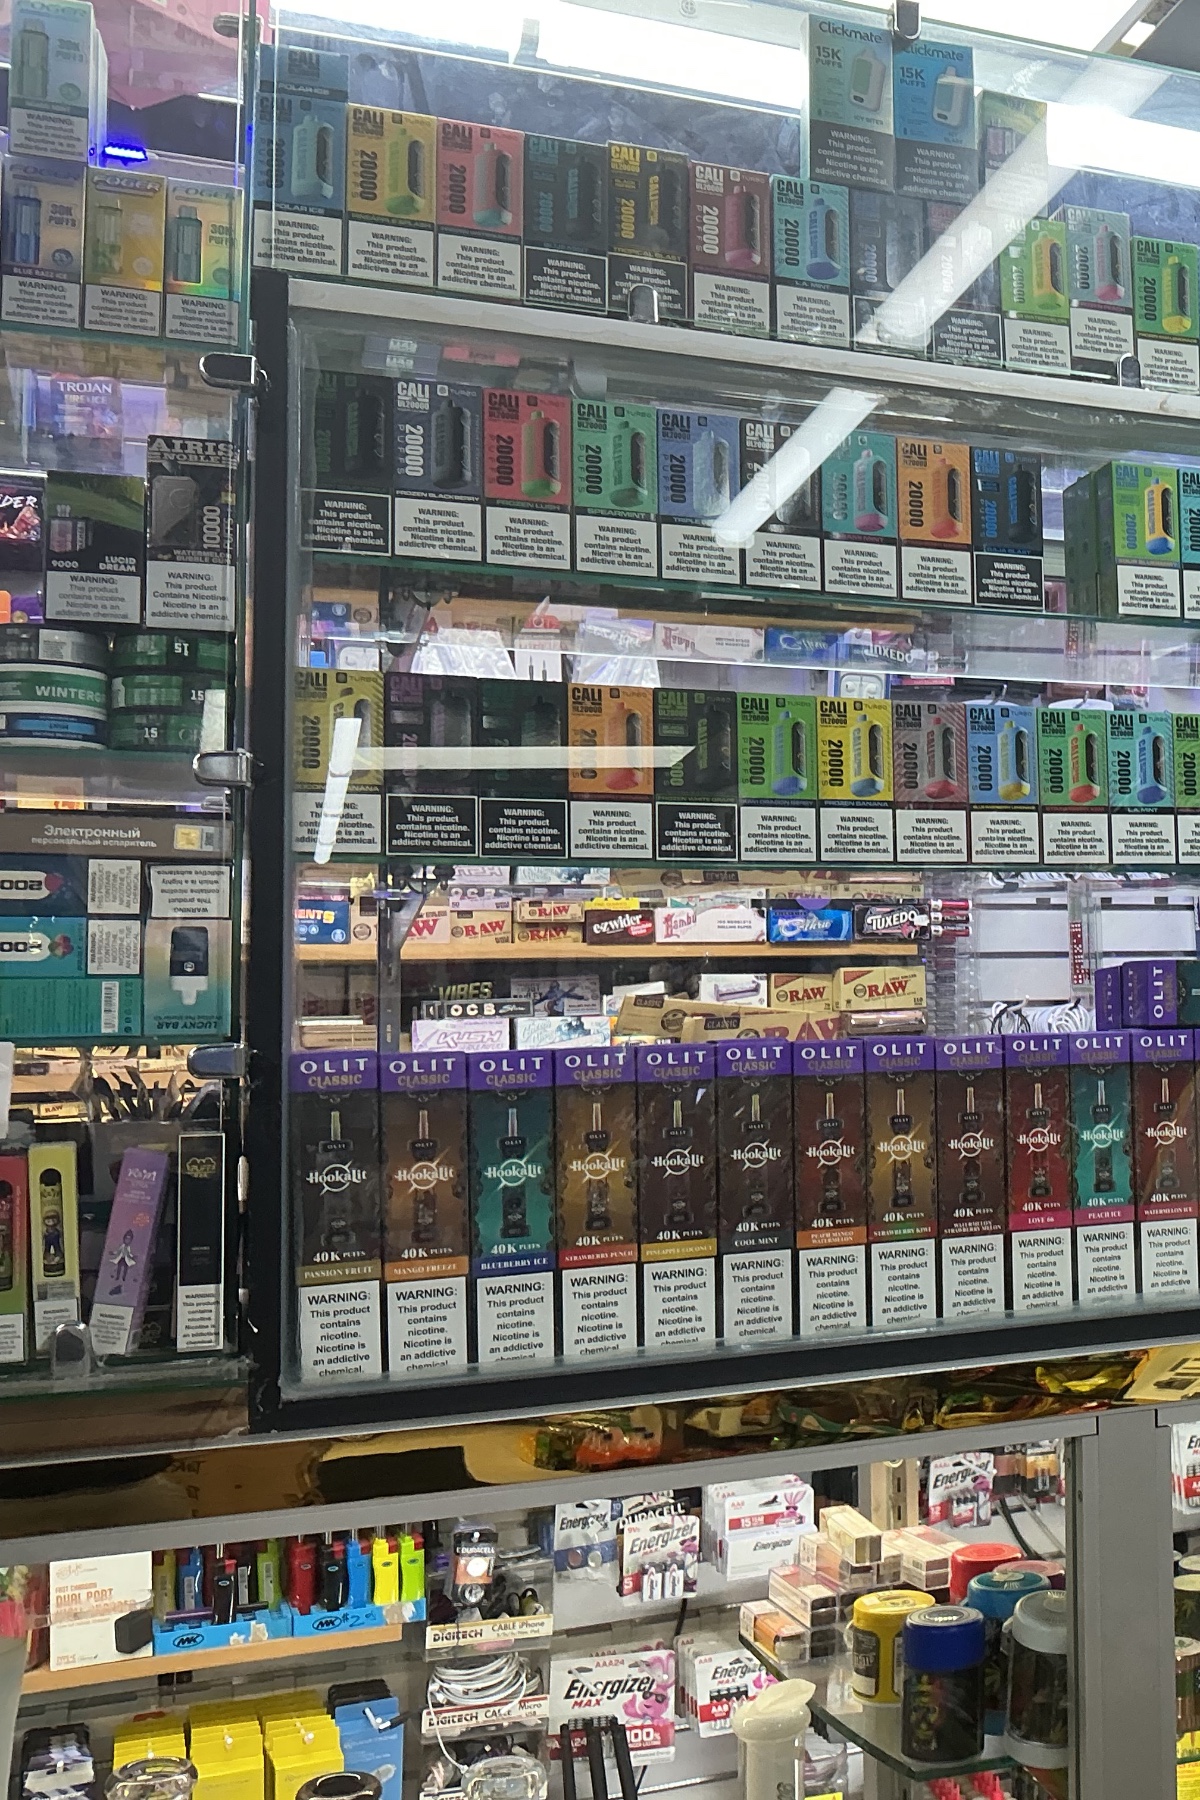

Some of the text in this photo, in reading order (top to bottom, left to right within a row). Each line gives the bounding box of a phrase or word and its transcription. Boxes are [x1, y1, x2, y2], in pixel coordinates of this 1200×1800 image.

[819, 21, 883, 43] Clickmate
[816, 45, 841, 61] 15K
[815, 58, 843, 69] PUFFS
[899, 66, 925, 81] 15K
[278, 82, 310, 95] POLAR
[899, 79, 926, 88] PUFFS
[353, 108, 384, 125] CALI
[830, 129, 873, 144] WARNING:
[828, 139, 877, 157] This product
[359, 149, 378, 201] 20000
[278, 219, 320, 232] WARNING:
[57, 382, 112, 394] TROJAN
[397, 382, 430, 398] CALI
[577, 404, 607, 420] CALI
[151, 438, 234, 456] AIRIS
[405, 424, 424, 478] 20000
[586, 444, 602, 495] 20000
[396, 490, 480, 502] FROZEN BLACKBERRY
[909, 481, 924, 528] 20000
[419, 508, 460, 518] WARNING:
[587, 508, 645, 520] SPEARMINT
[203, 505, 221, 550] 10000
[413, 517, 465, 529] This product
[403, 526, 475, 537] contains nicotine.
[399, 541, 478, 553] addictive chemical.
[52, 560, 79, 568] 9000
[105, 556, 136, 565] LUCID
[99, 563, 136, 573] DREAM
[167, 572, 215, 582] WARNING:
[164, 581, 218, 593] This product
[190, 690, 204, 701] 15
[572, 687, 602, 701] CALI
[741, 697, 769, 710] CALI
[820, 700, 847, 714] CALI
[1110, 714, 1133, 727] CALI
[144, 728, 158, 739] 15
[749, 737, 765, 785] 20000
[828, 740, 844, 787] 20000
[1117, 750, 1132, 795] 20000
[824, 800, 855, 808] FROZEN
[593, 810, 631, 818] WARNING:
[44, 825, 141, 839] Электронный
[537, 905, 570, 917] RAW
[593, 914, 643, 935] ezwider
[867, 910, 918, 931] TUXEDO
[464, 920, 506, 937] RAW
[439, 981, 494, 1001] VIBES
[789, 986, 827, 1002] RAW
[867, 980, 910, 998] RAW
[157, 1021, 218, 1030] LUCKY BAR
[705, 1018, 740, 1030] CLASSIC
[725, 1046, 784, 1061] OLIT
[801, 1045, 858, 1060] OLIT
[872, 1042, 927, 1056] OLIT
[943, 1041, 996, 1055] OLIT
[479, 1056, 544, 1073] OLIT
[564, 1052, 628, 1068] OLIT
[646, 1050, 707, 1066] OLIT
[299, 1057, 369, 1075] OLIT
[389, 1057, 456, 1075] OLIT
[1088, 1210, 1122, 1219] PEACH ICE
[1144, 1206, 1193, 1216] WATERMELON ICE
[734, 1236, 780, 1247] COOL MINT
[564, 1250, 634, 1262] STRAWBERRY PUNCH
[393, 1265, 421, 1276] MANGO
[481, 1257, 549, 1271] BLUEBERRY ICE
[304, 1265, 373, 1280] PASSION FRUIT
[307, 1290, 371, 1306] WARNING:
[310, 1305, 371, 1319] This product
[320, 1318, 361, 1330] contains
[320, 1330, 362, 1342] nicotine.
[316, 1341, 366, 1355] Nicotine is
[312, 1352, 370, 1367] an addictive
[740, 1518, 752, 1528] 15
[629, 1522, 697, 1556] Energizer
[753, 1538, 794, 1552] Energizer
[461, 1546, 495, 1555] DURACELL
[56, 1588, 114, 1608] DUAL PORT
[433, 1620, 546, 1643] DIGITECH CABLE iPhone
[595, 1659, 625, 1669] AAA24
[518, 1701, 542, 1711] Micro
[571, 1698, 603, 1710] MAX
